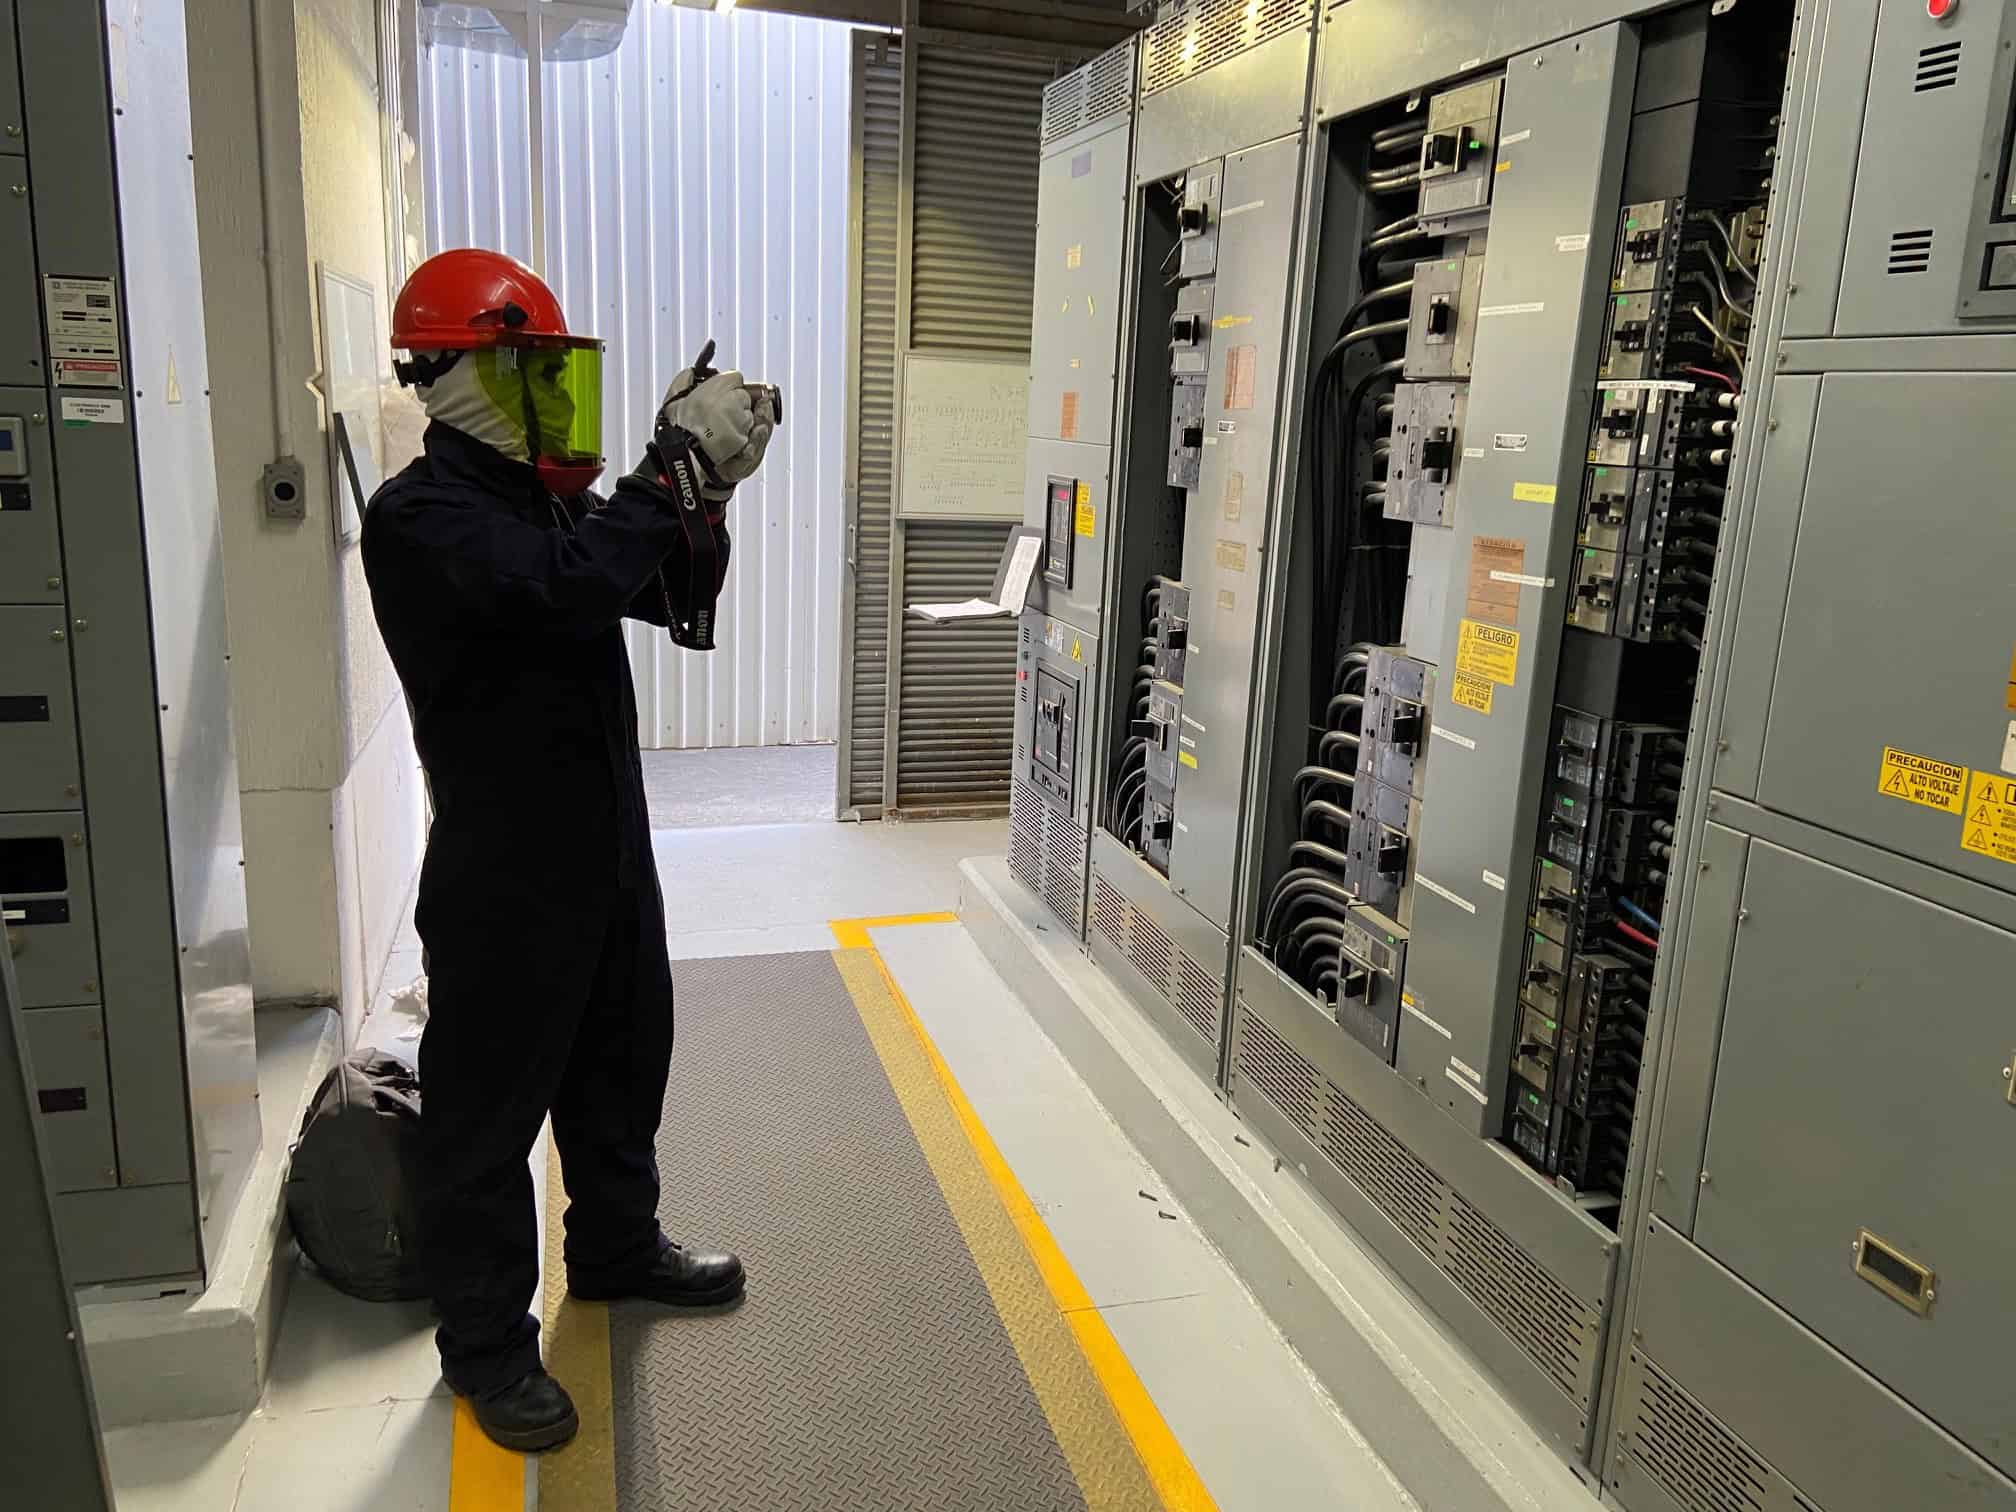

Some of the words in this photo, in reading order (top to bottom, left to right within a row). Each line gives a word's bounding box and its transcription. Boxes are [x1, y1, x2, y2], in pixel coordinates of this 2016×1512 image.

[673, 459, 697, 510] Canon
[1478, 628, 1513, 645] PELIGRO
[1889, 752, 1961, 779] PRECAUCION
[1909, 772, 1927, 787] ALTO
[1929, 778, 1960, 796] VOLTAJE
[1914, 788, 1925, 801] NO
[1927, 791, 1950, 807] TOCAR
